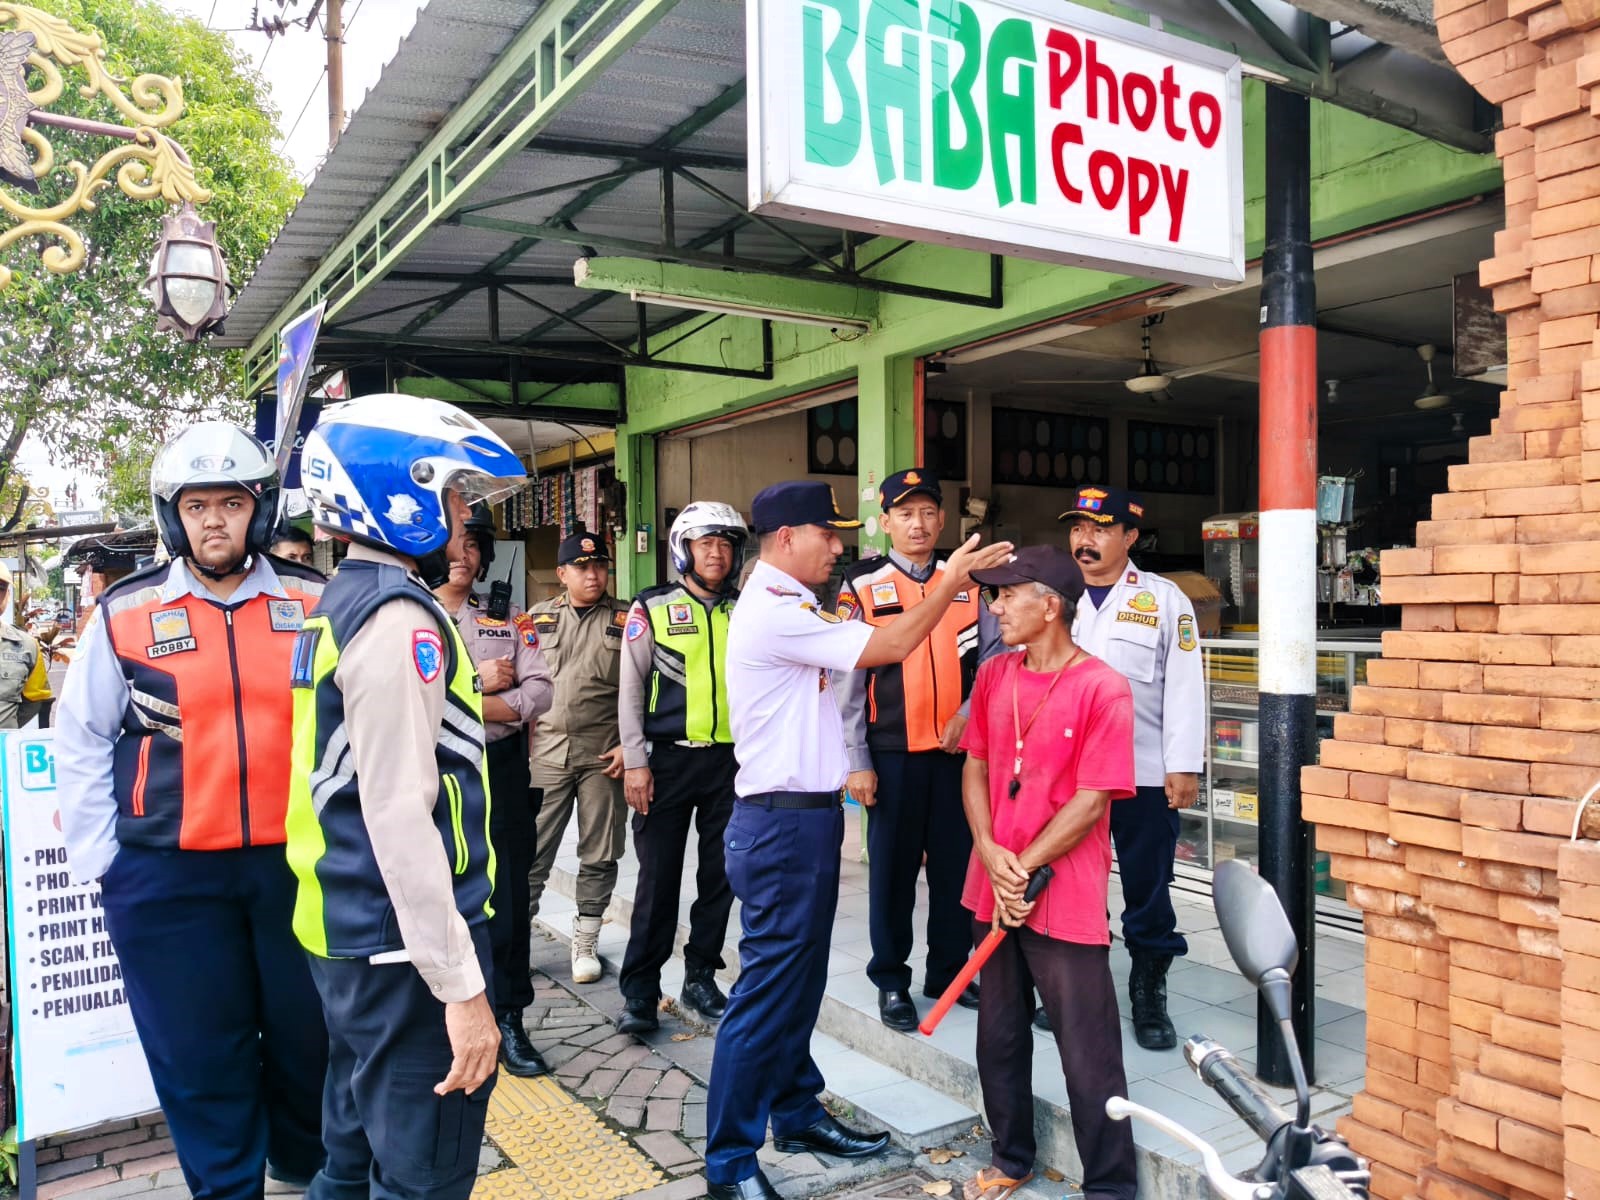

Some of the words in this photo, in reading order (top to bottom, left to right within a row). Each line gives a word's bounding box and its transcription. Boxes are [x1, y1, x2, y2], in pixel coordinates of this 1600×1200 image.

[1046, 28, 1222, 149] Photo
[801, 0, 1037, 207] BABA
[1052, 122, 1189, 242] Copy
[155, 610, 185, 623] DISHUB
[1118, 612, 1156, 626] DISHUB
[478, 628, 512, 638] POLRI
[152, 639, 191, 656] ROBBY
[25, 744, 56, 784] Bi
[35, 846, 68, 867] PHO
[37, 894, 86, 916] PRINT
[89, 891, 104, 909] W
[39, 918, 88, 941] PRINT
[40, 943, 88, 967] SCAN,
[92, 940, 115, 959] FIL
[41, 963, 121, 993] PENJILIDA
